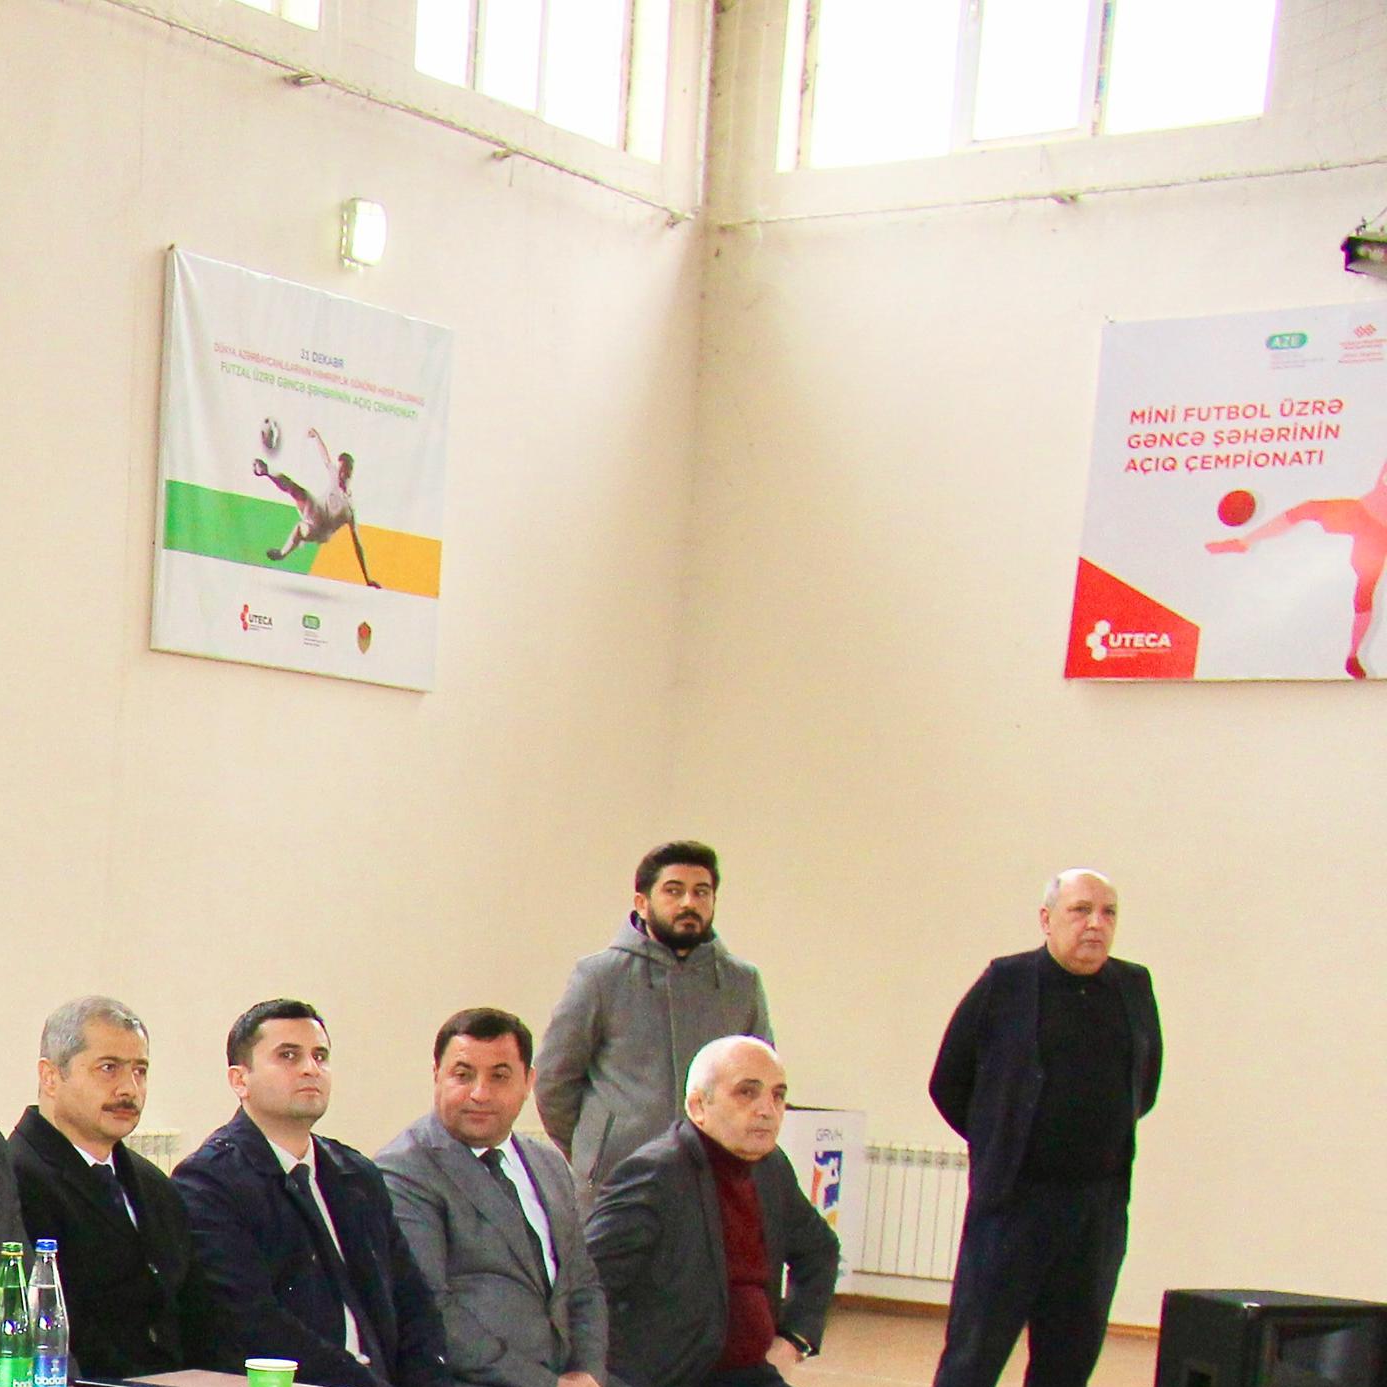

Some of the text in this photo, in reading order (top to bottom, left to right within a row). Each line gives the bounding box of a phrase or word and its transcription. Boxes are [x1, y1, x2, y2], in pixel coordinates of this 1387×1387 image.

[1130, 398, 1344, 425] MİNİ FUTBOL ÜZRƏ
[1128, 422, 1341, 449] GƏNCƏ ŞƏHƏRİNİN
[1125, 450, 1325, 474] AÇIQ ÇEMPİONATI
[249, 613, 273, 626] UTECA
[1108, 632, 1172, 648] UTECA
